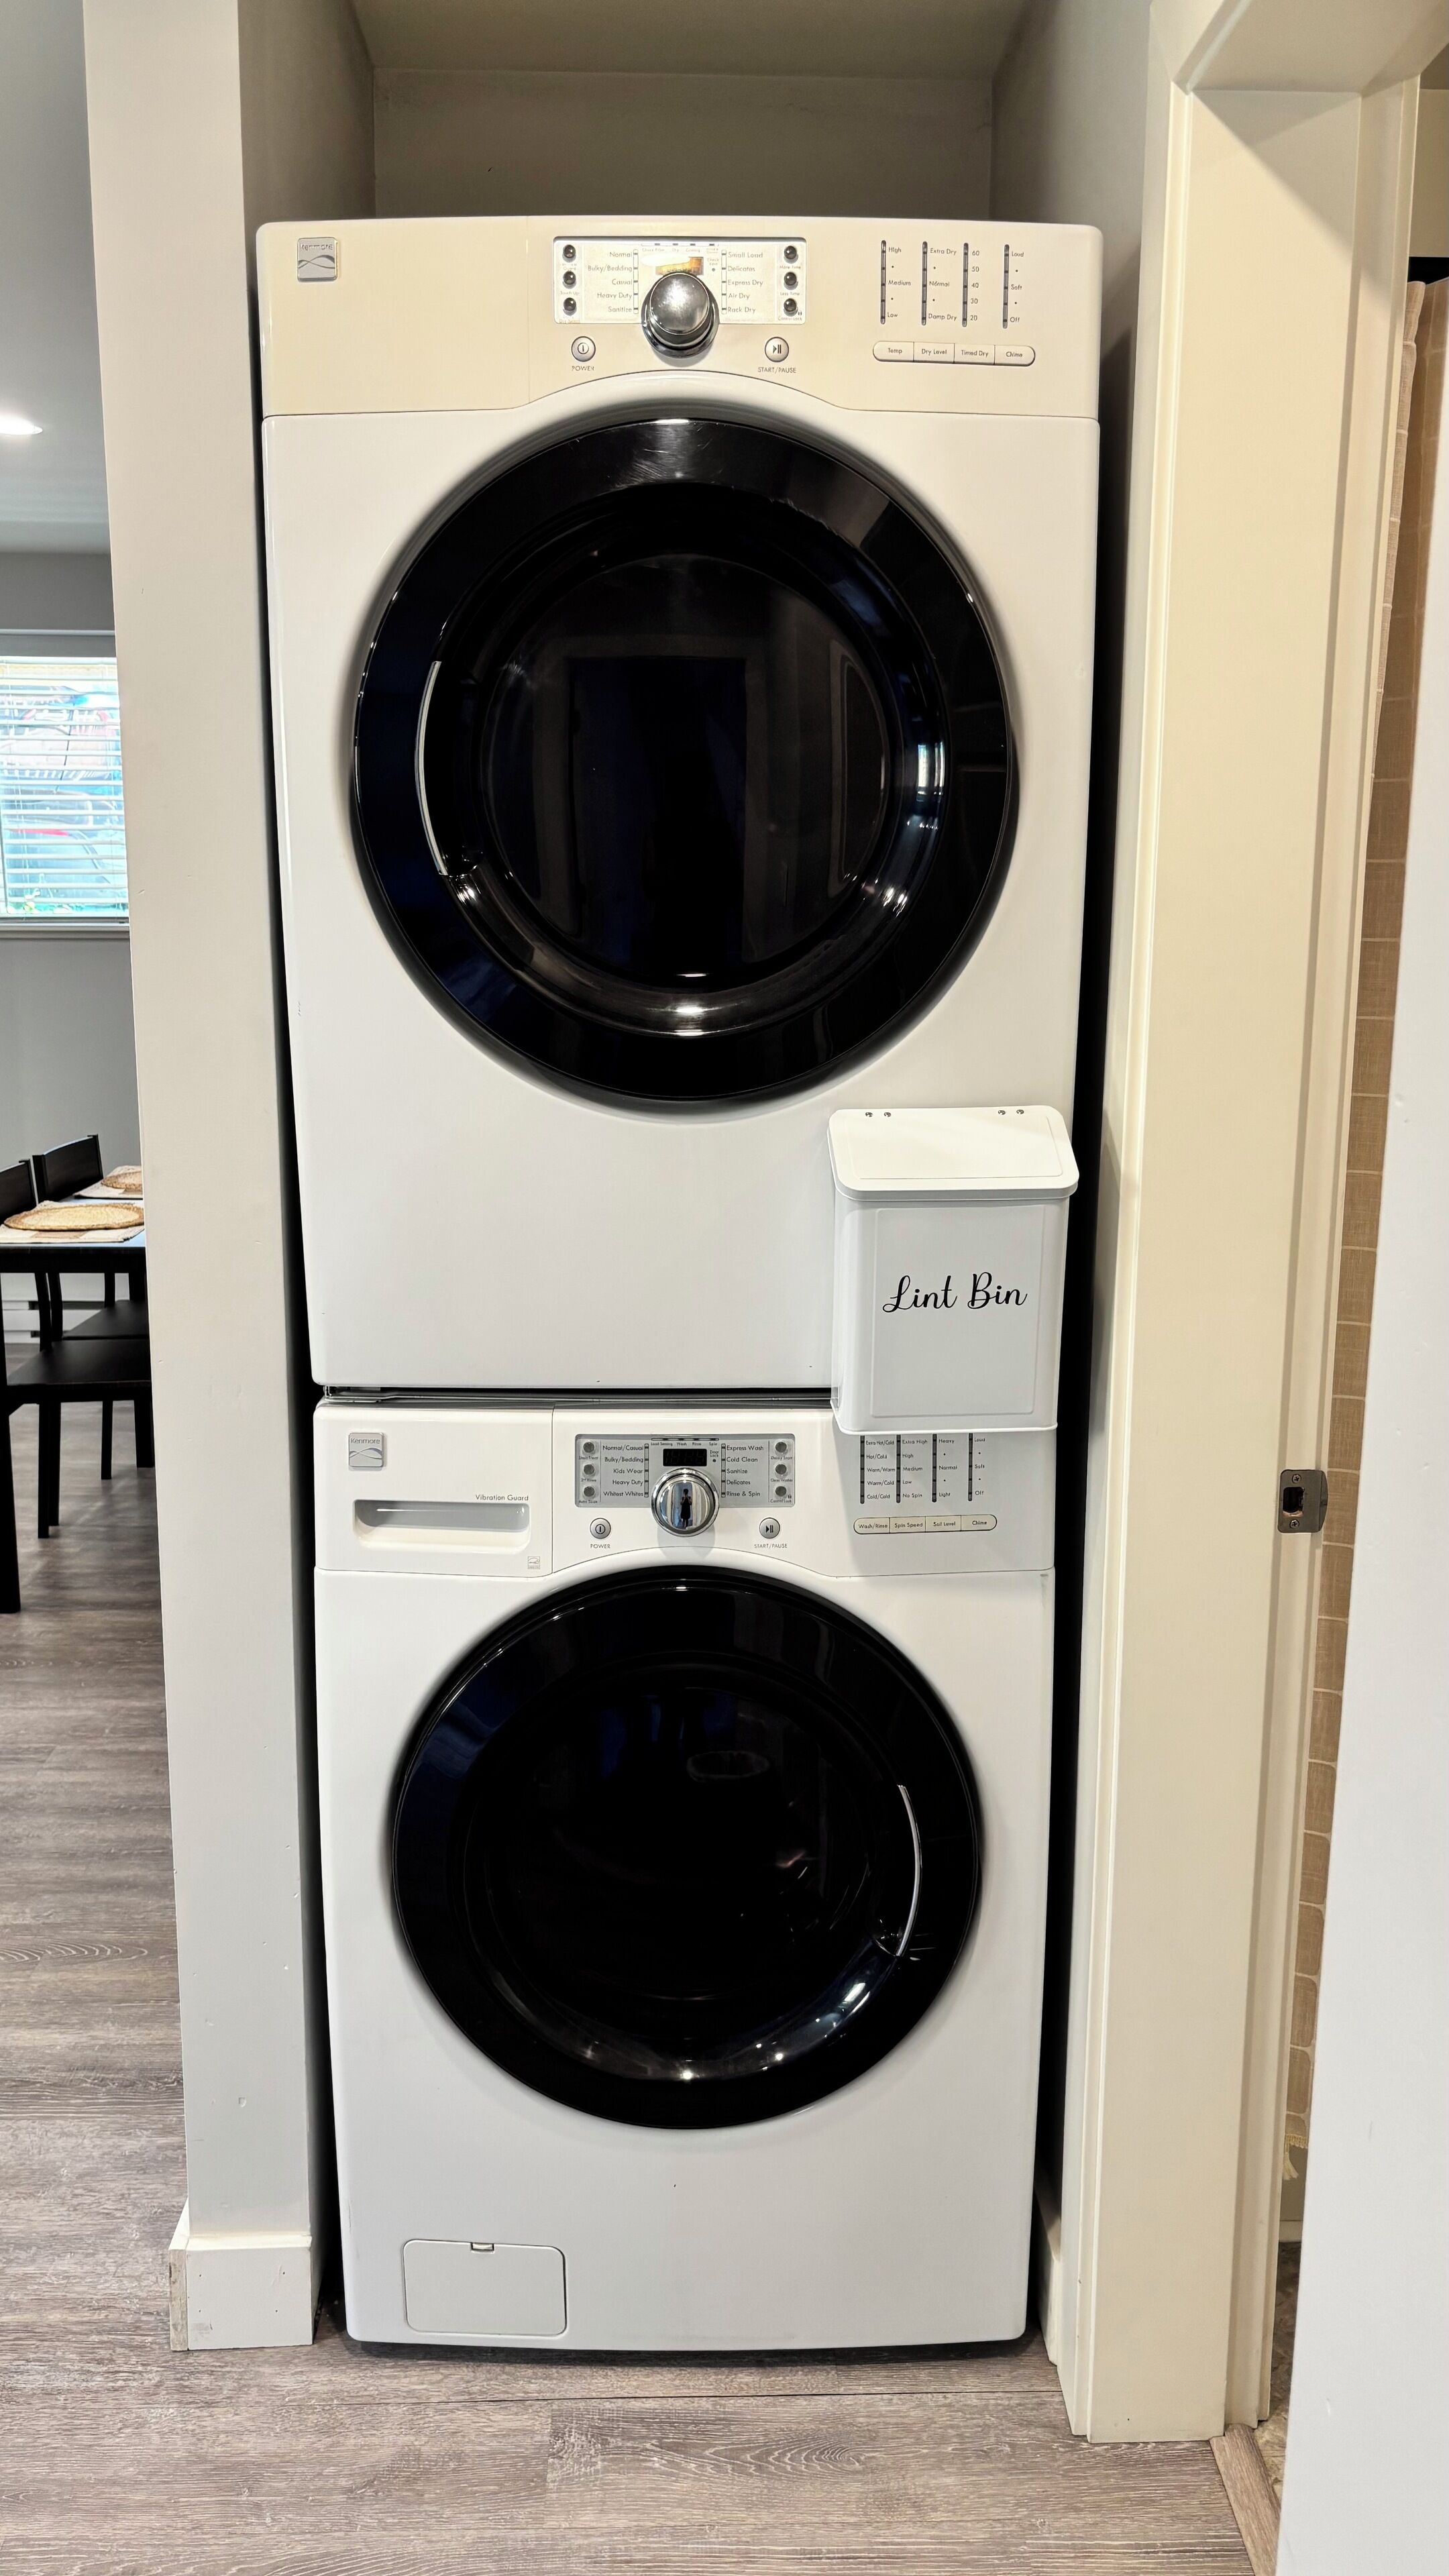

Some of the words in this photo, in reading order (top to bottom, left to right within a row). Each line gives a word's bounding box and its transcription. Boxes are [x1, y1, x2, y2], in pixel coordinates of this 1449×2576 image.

[588, 264, 633, 274] Bulky/Bedding
[619, 292, 633, 301] Duty
[739, 292, 750, 301] Dry
[745, 307, 756, 315] Dry
[882, 1275, 958, 1313] Lint
[967, 1272, 1028, 1309] Bin
[476, 1493, 505, 1501] Vibration
